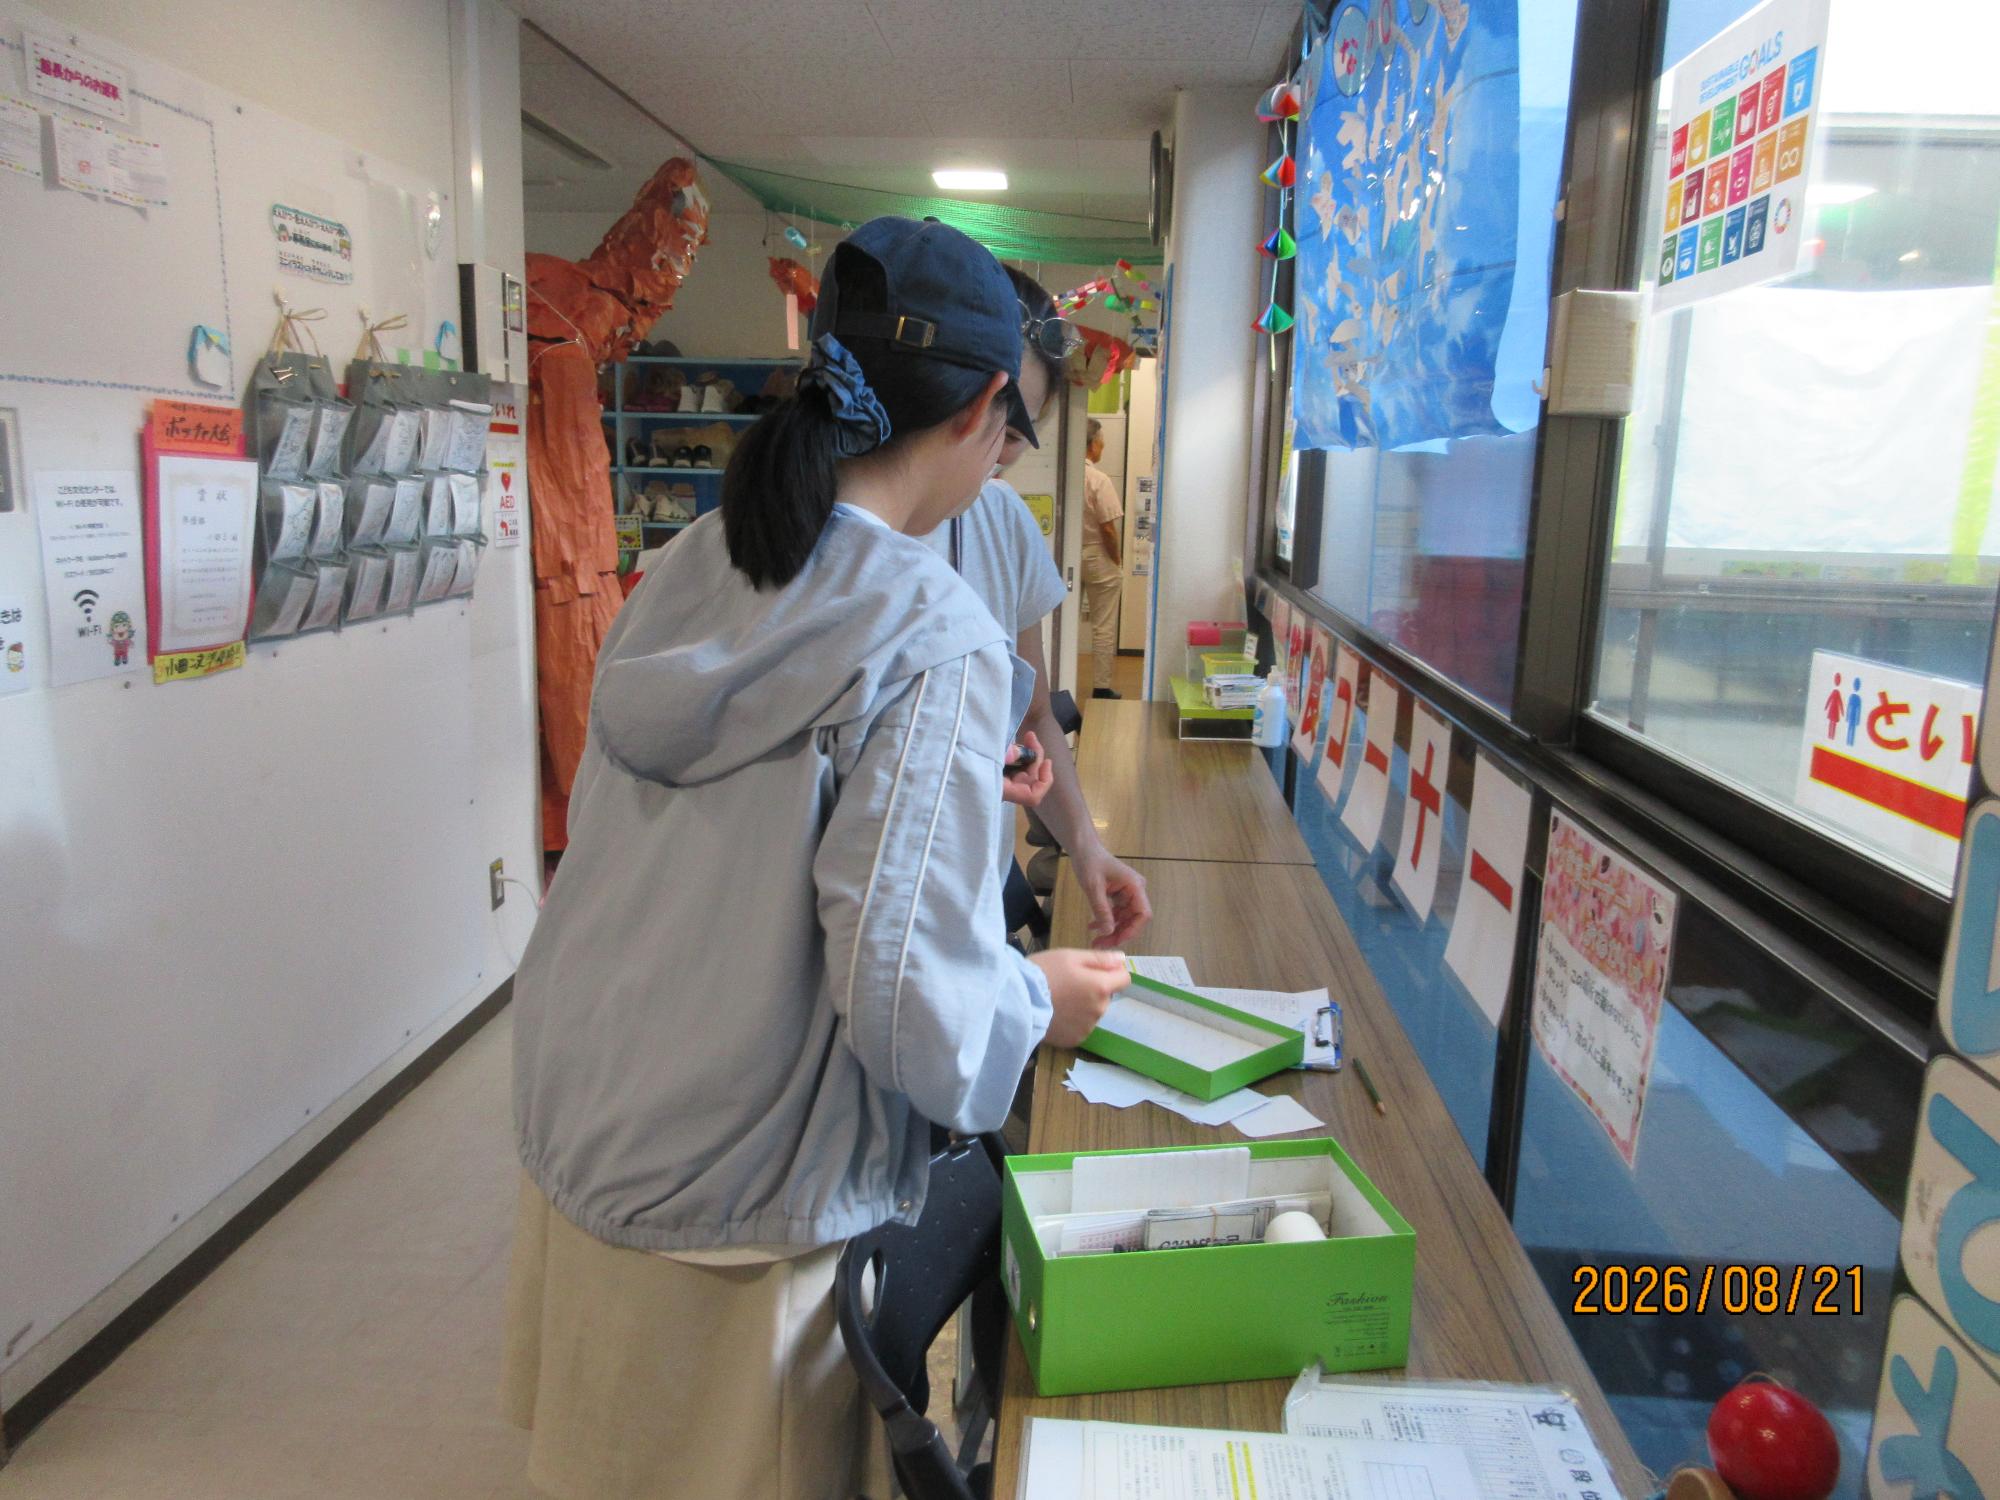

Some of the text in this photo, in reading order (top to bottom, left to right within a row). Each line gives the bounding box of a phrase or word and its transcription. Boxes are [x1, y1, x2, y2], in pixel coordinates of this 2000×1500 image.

[1740, 30, 1783, 80] GOALS
[500, 495, 515, 509] AED
[78, 624, 102, 637] Wi-Fi
